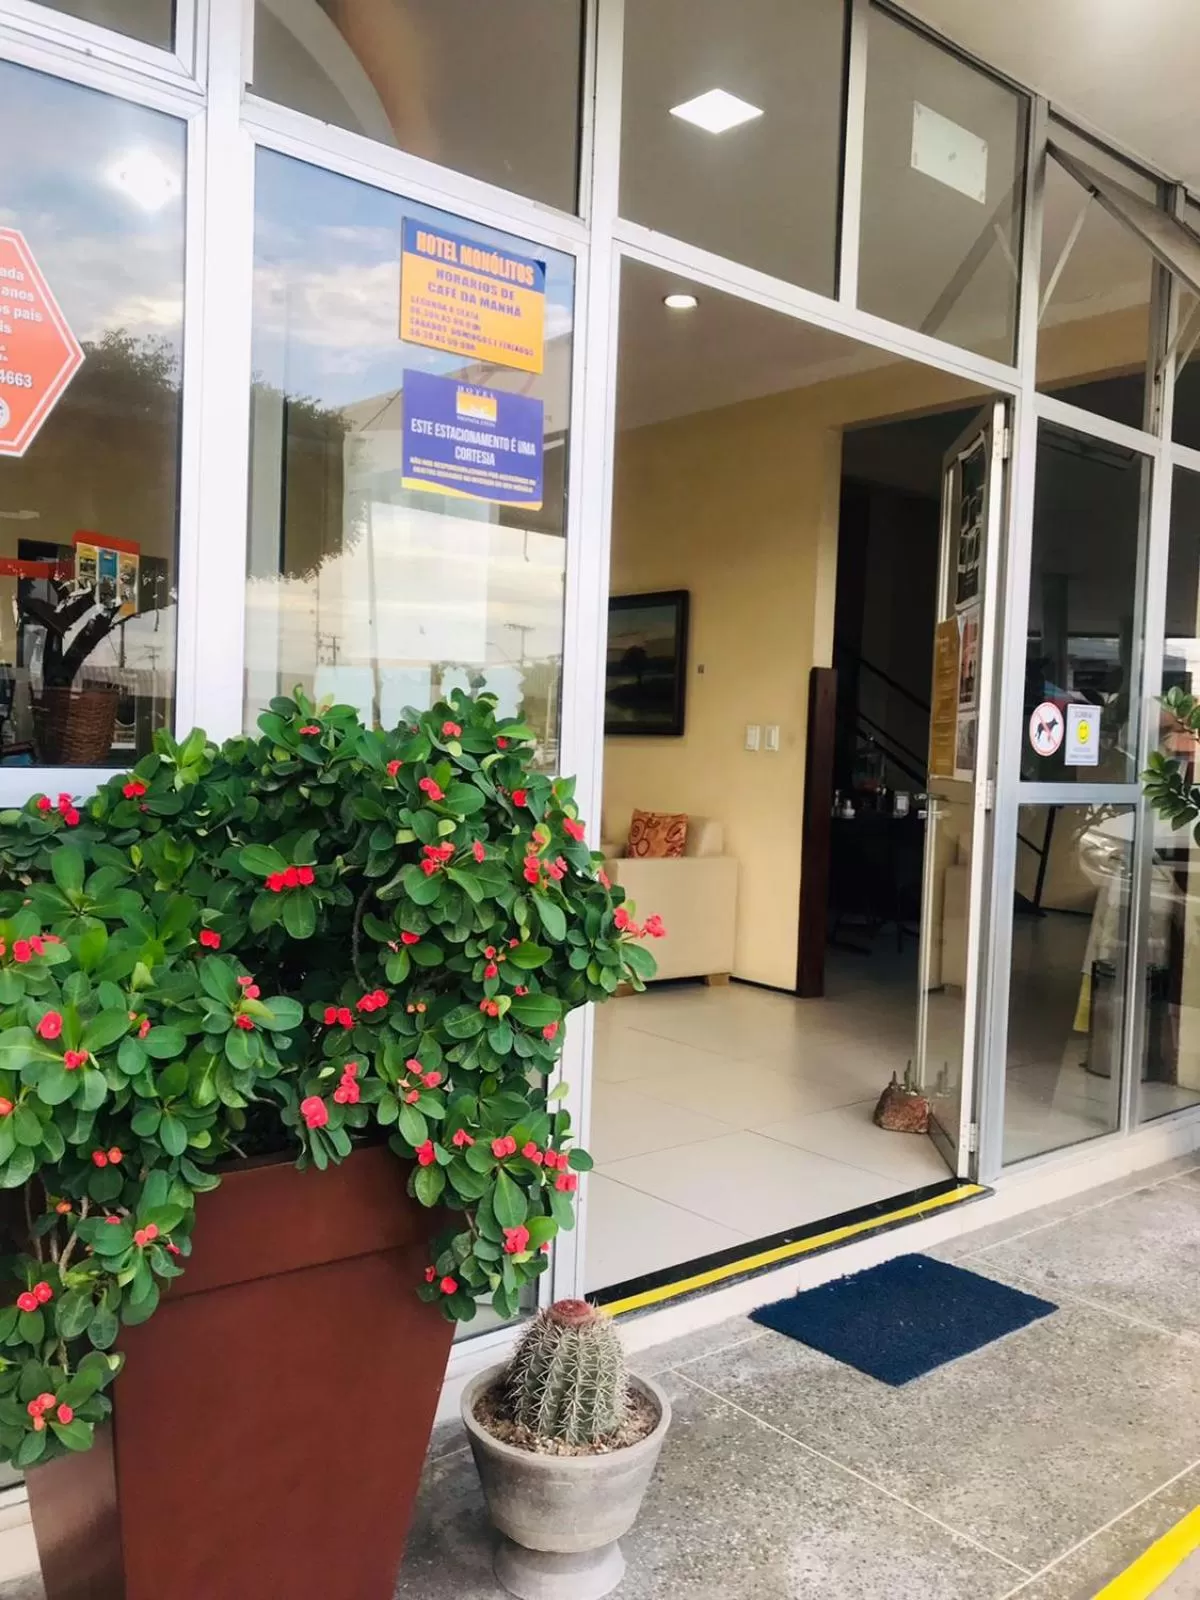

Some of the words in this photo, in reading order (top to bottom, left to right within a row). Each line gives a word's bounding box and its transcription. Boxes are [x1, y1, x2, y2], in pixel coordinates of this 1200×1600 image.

[416, 230, 458, 262] HOTEL
[460, 244, 534, 286] MONÓLITOS
[0, 286, 34, 302] anos
[461, 291, 477, 305] DA
[411, 418, 433, 436] ESTE
[435, 423, 510, 451] ESTACIONAMENTO
[511, 437, 516, 452] É
[517, 440, 536, 457] UMA
[455, 446, 496, 466] CORTESIA
